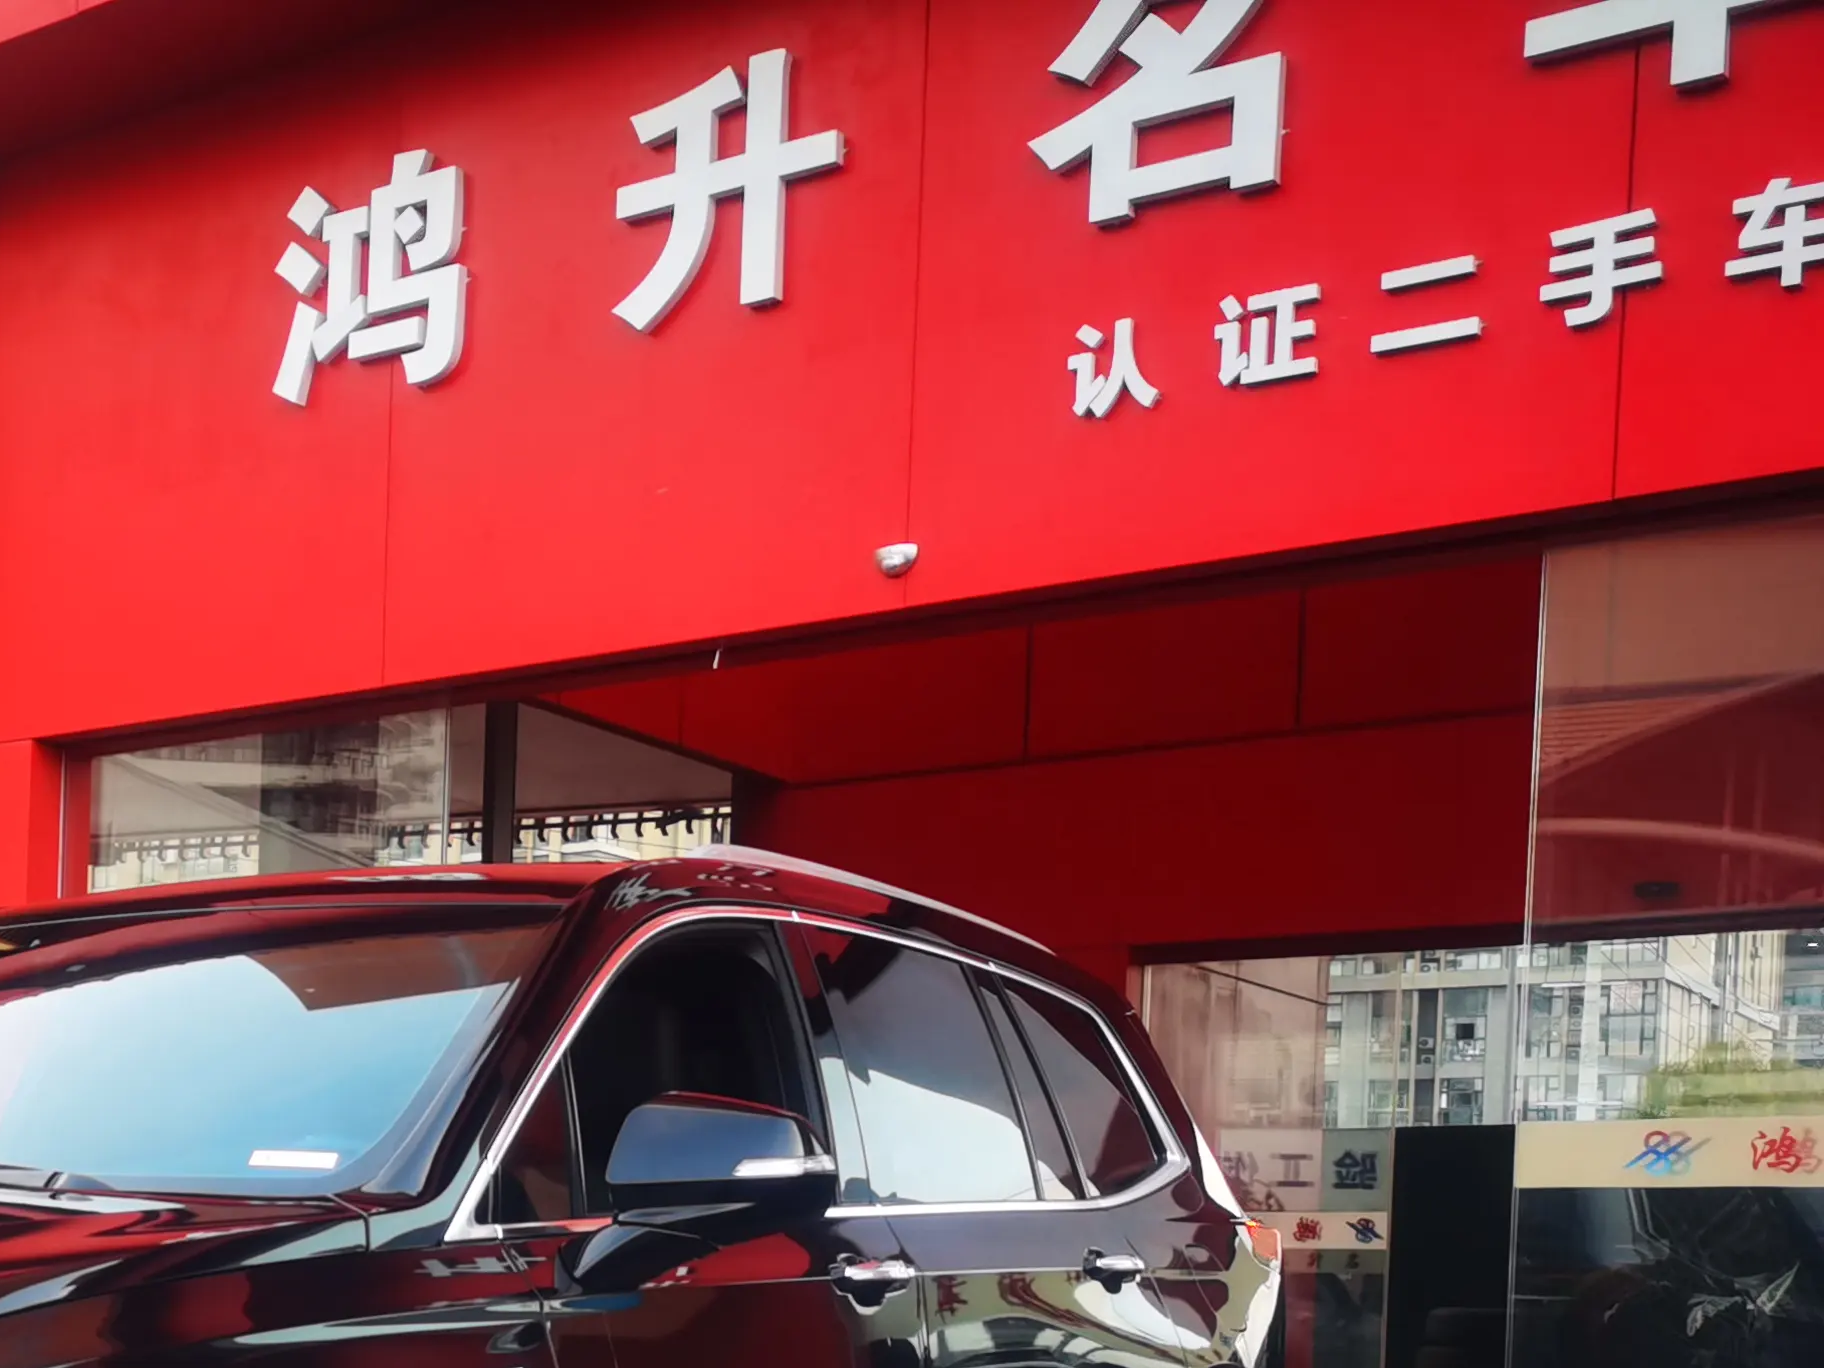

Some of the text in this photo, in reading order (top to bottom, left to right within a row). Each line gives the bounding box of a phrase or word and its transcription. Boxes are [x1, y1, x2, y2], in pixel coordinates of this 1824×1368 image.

[1066, 177, 1824, 419] 认证二手车
